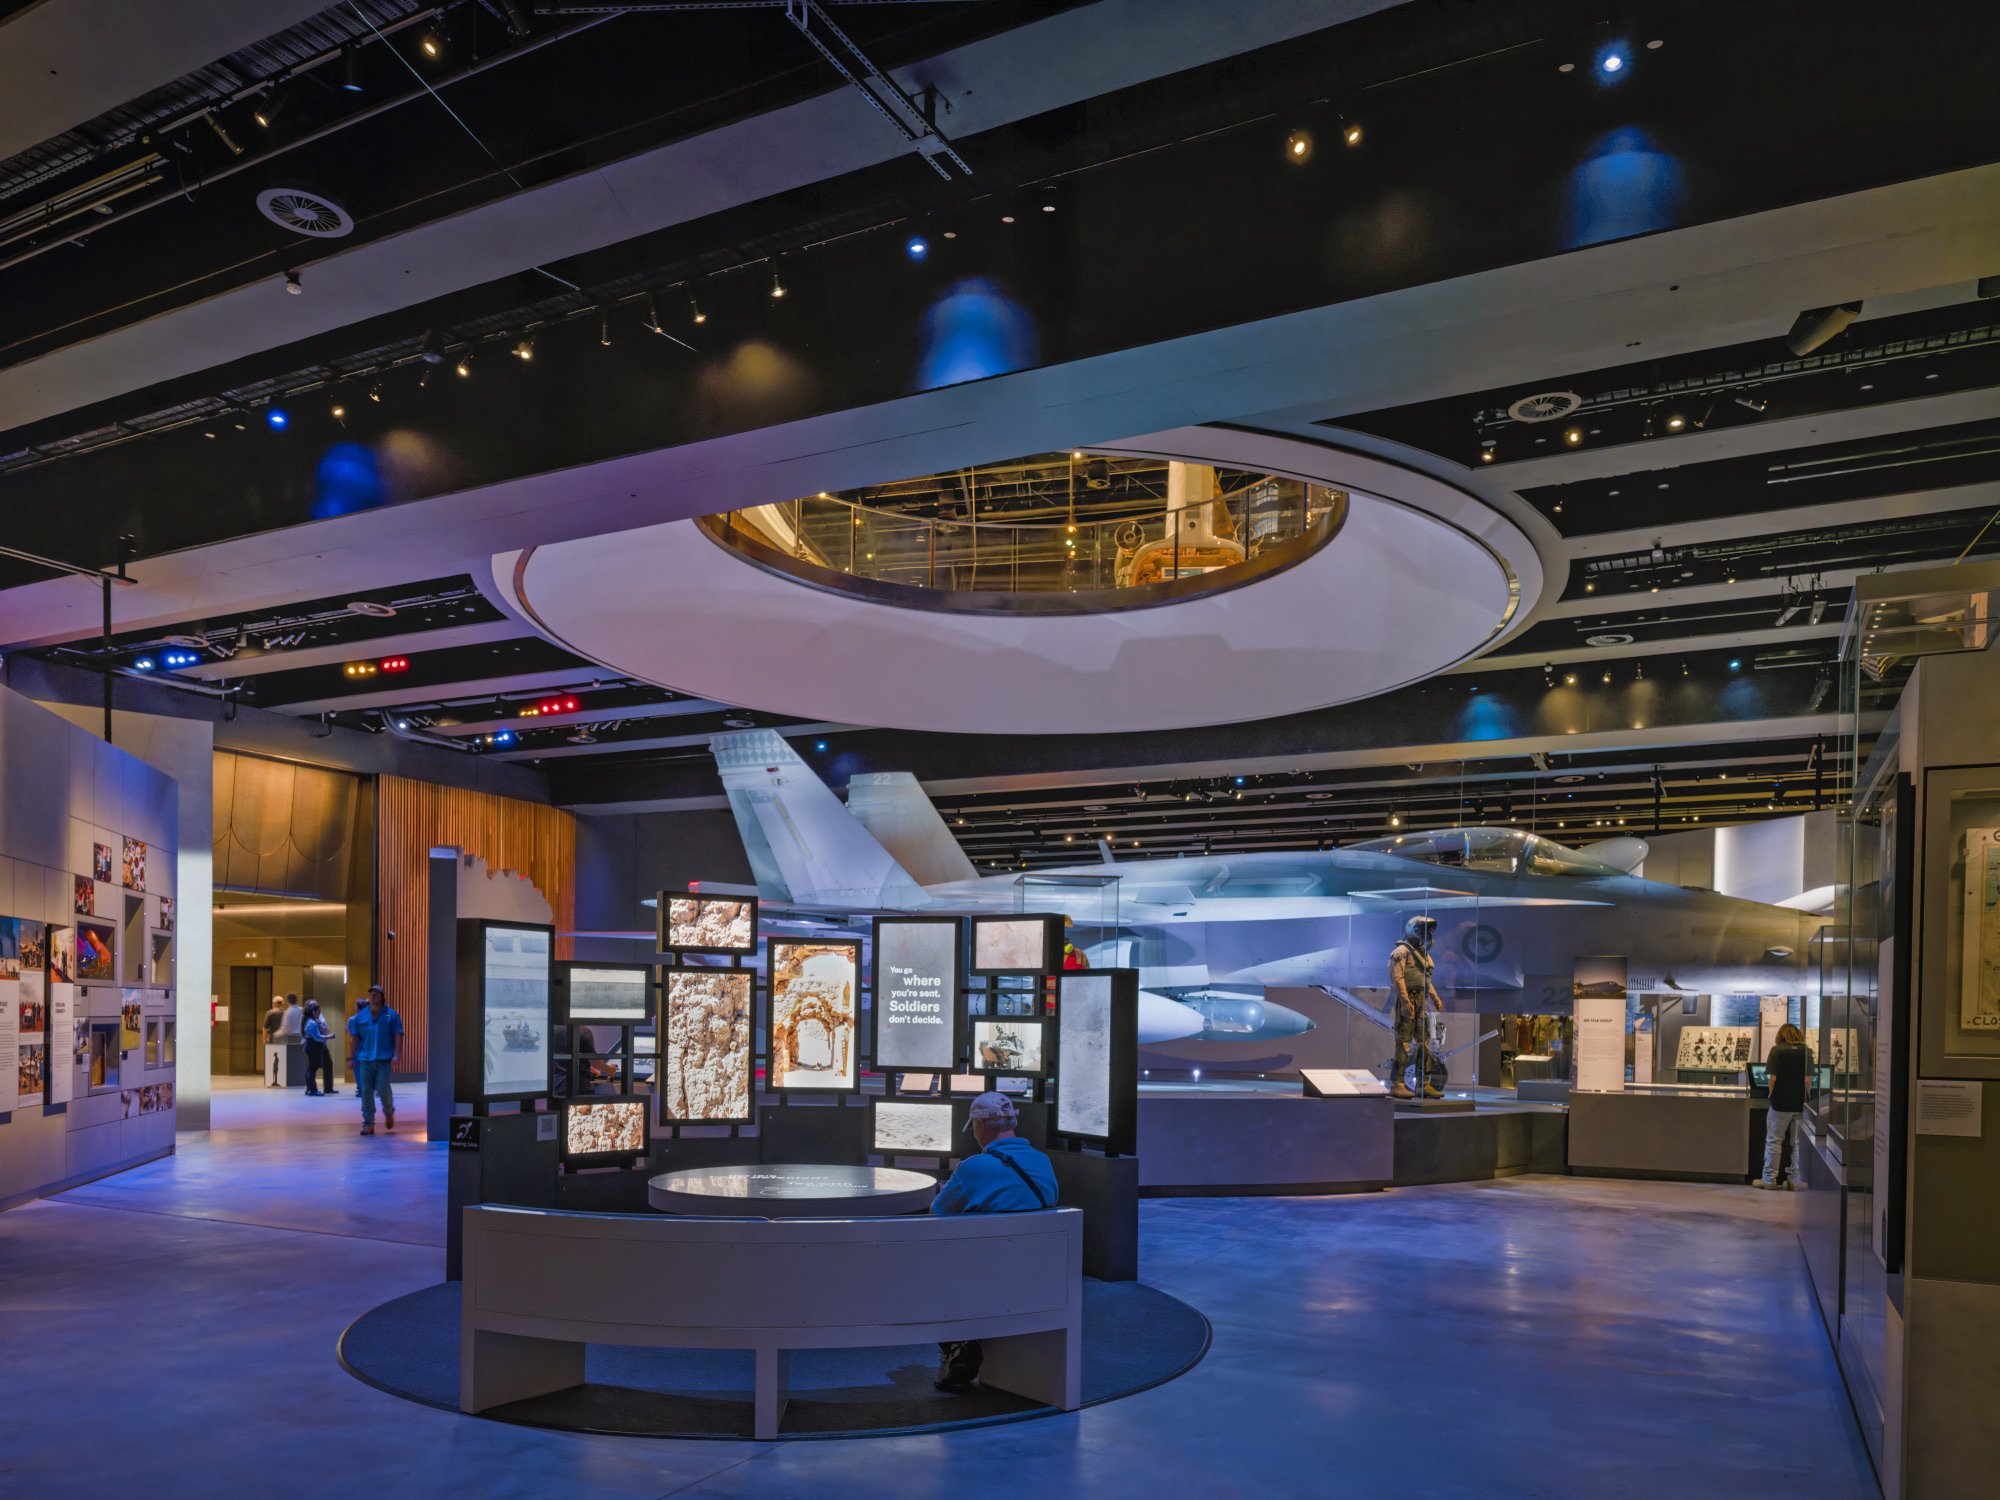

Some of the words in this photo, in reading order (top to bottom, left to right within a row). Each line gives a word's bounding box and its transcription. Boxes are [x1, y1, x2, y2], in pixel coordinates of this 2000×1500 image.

[873, 773, 892, 785] 22
[890, 966, 903, 974] You
[903, 967, 913, 975] go
[903, 974, 941, 986] where
[891, 988, 918, 998] you're
[919, 989, 941, 998] sent.
[889, 1000, 940, 1013] Soldiers
[888, 1014, 911, 1024] don't
[912, 1015, 944, 1024] decide.
[1972, 1016, 2000, 1026] CLO
